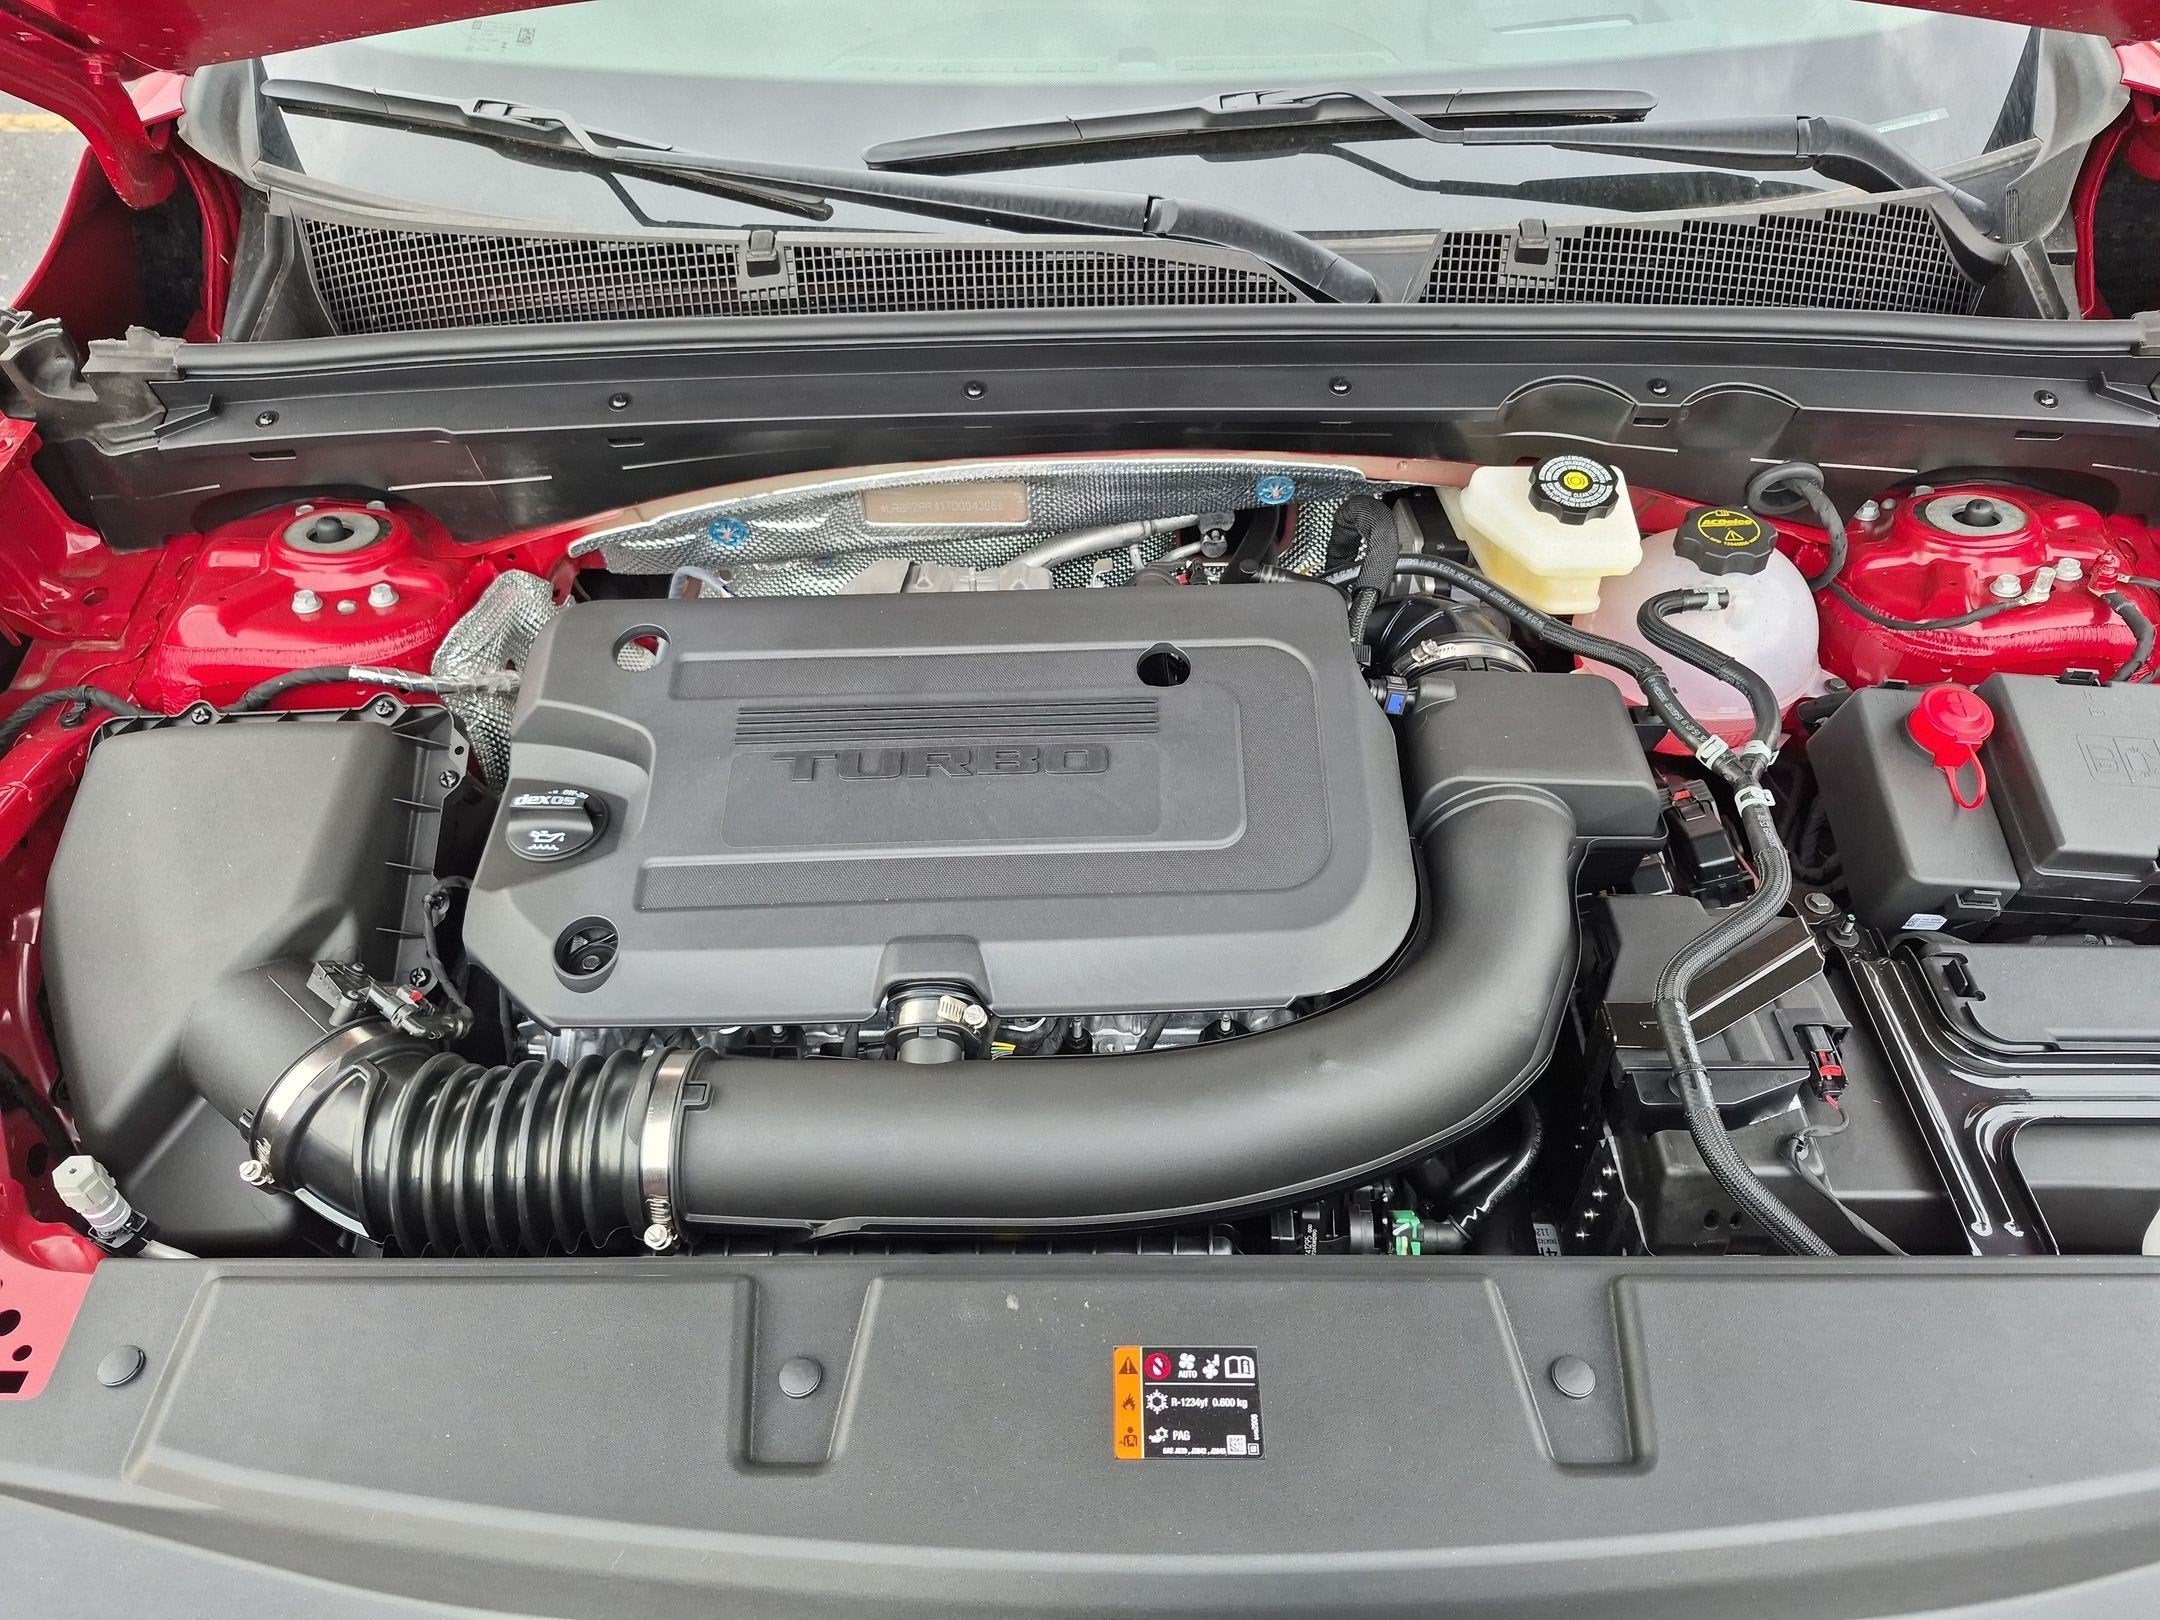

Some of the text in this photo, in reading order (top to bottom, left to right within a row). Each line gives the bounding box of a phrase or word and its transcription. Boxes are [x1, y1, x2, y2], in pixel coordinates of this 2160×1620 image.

[1701, 518, 1753, 527] ACDelco
[772, 746, 1109, 782] TURBO
[513, 793, 578, 806] dexos
[1177, 1370, 1198, 1379] AUTO
[1170, 1397, 1249, 1409] R-1234yf 0.600 kg
[1172, 1430, 1191, 1441] PAG
